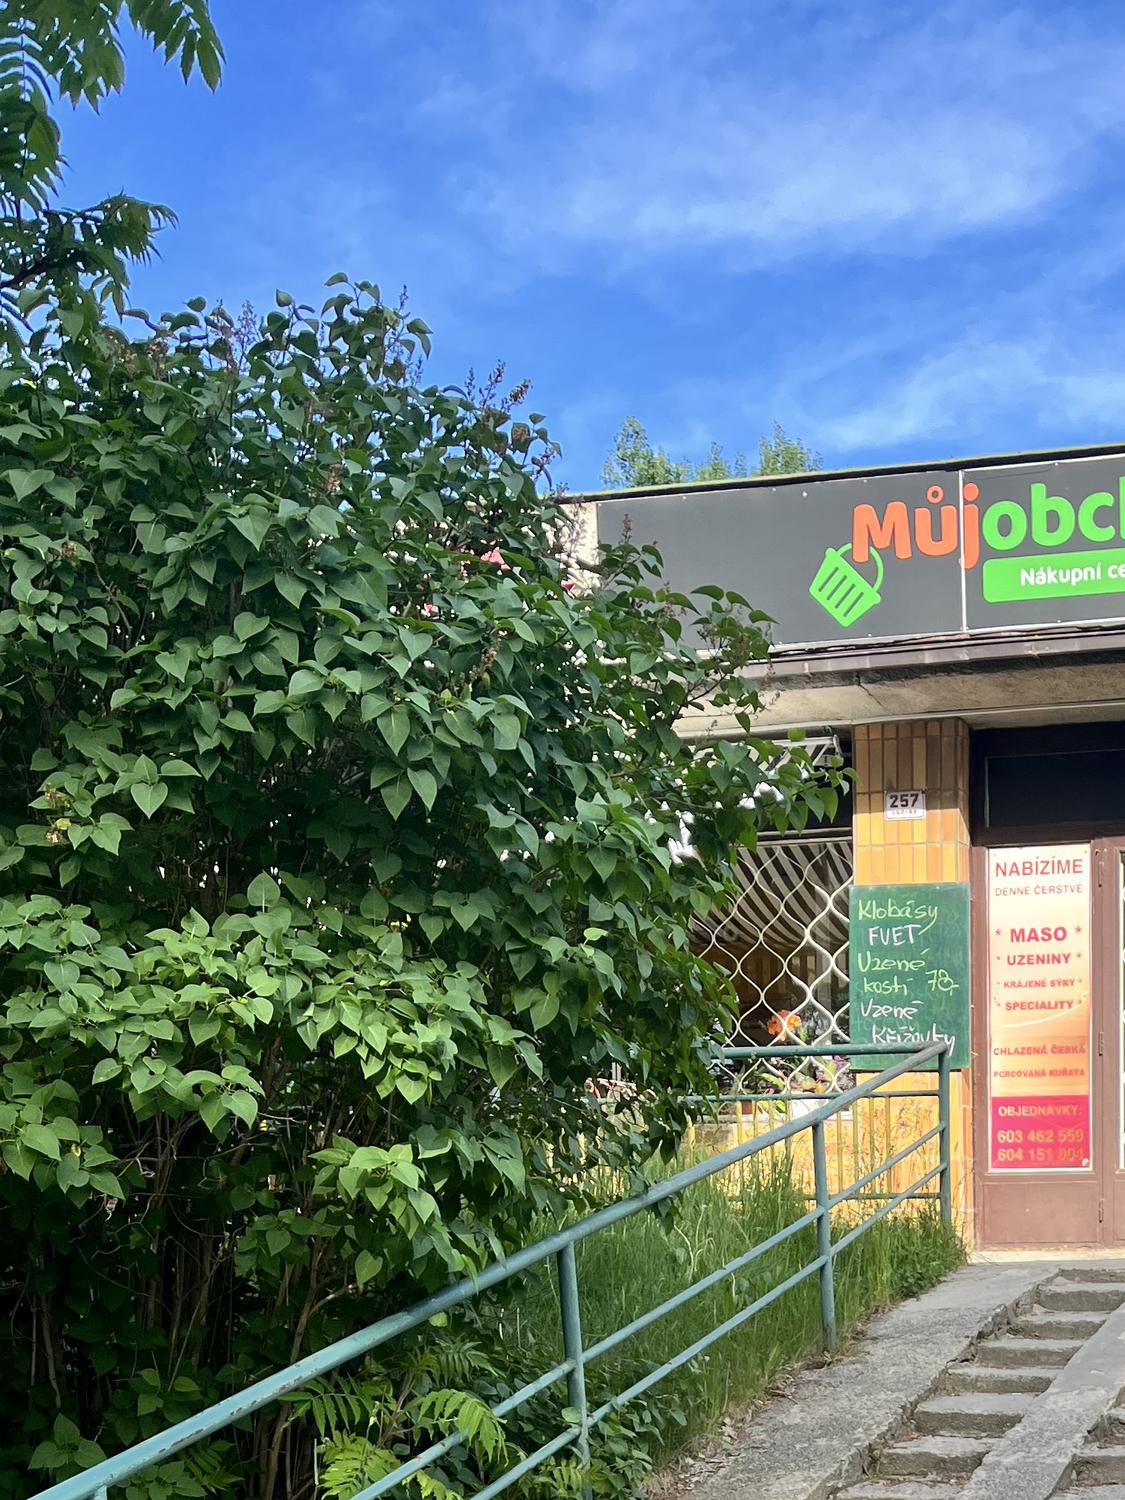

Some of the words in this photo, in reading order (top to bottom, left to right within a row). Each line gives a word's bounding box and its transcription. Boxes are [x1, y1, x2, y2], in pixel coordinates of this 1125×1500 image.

[1020, 562, 1102, 586] Nákupní
[889, 793, 919, 808] 257
[995, 856, 1083, 877] NABÍZÍME
[858, 898, 938, 935] Klobásy
[868, 924, 921, 946] FUET
[1010, 927, 1067, 943] MASO
[857, 948, 931, 972] Uzené
[1007, 953, 1071, 966] UZENINY
[1005, 1000, 1073, 1011] SPECIALITY
[997, 1130, 1023, 1143] 603
[1027, 1129, 1054, 1142] 462
[997, 1148, 1023, 1161] 604
